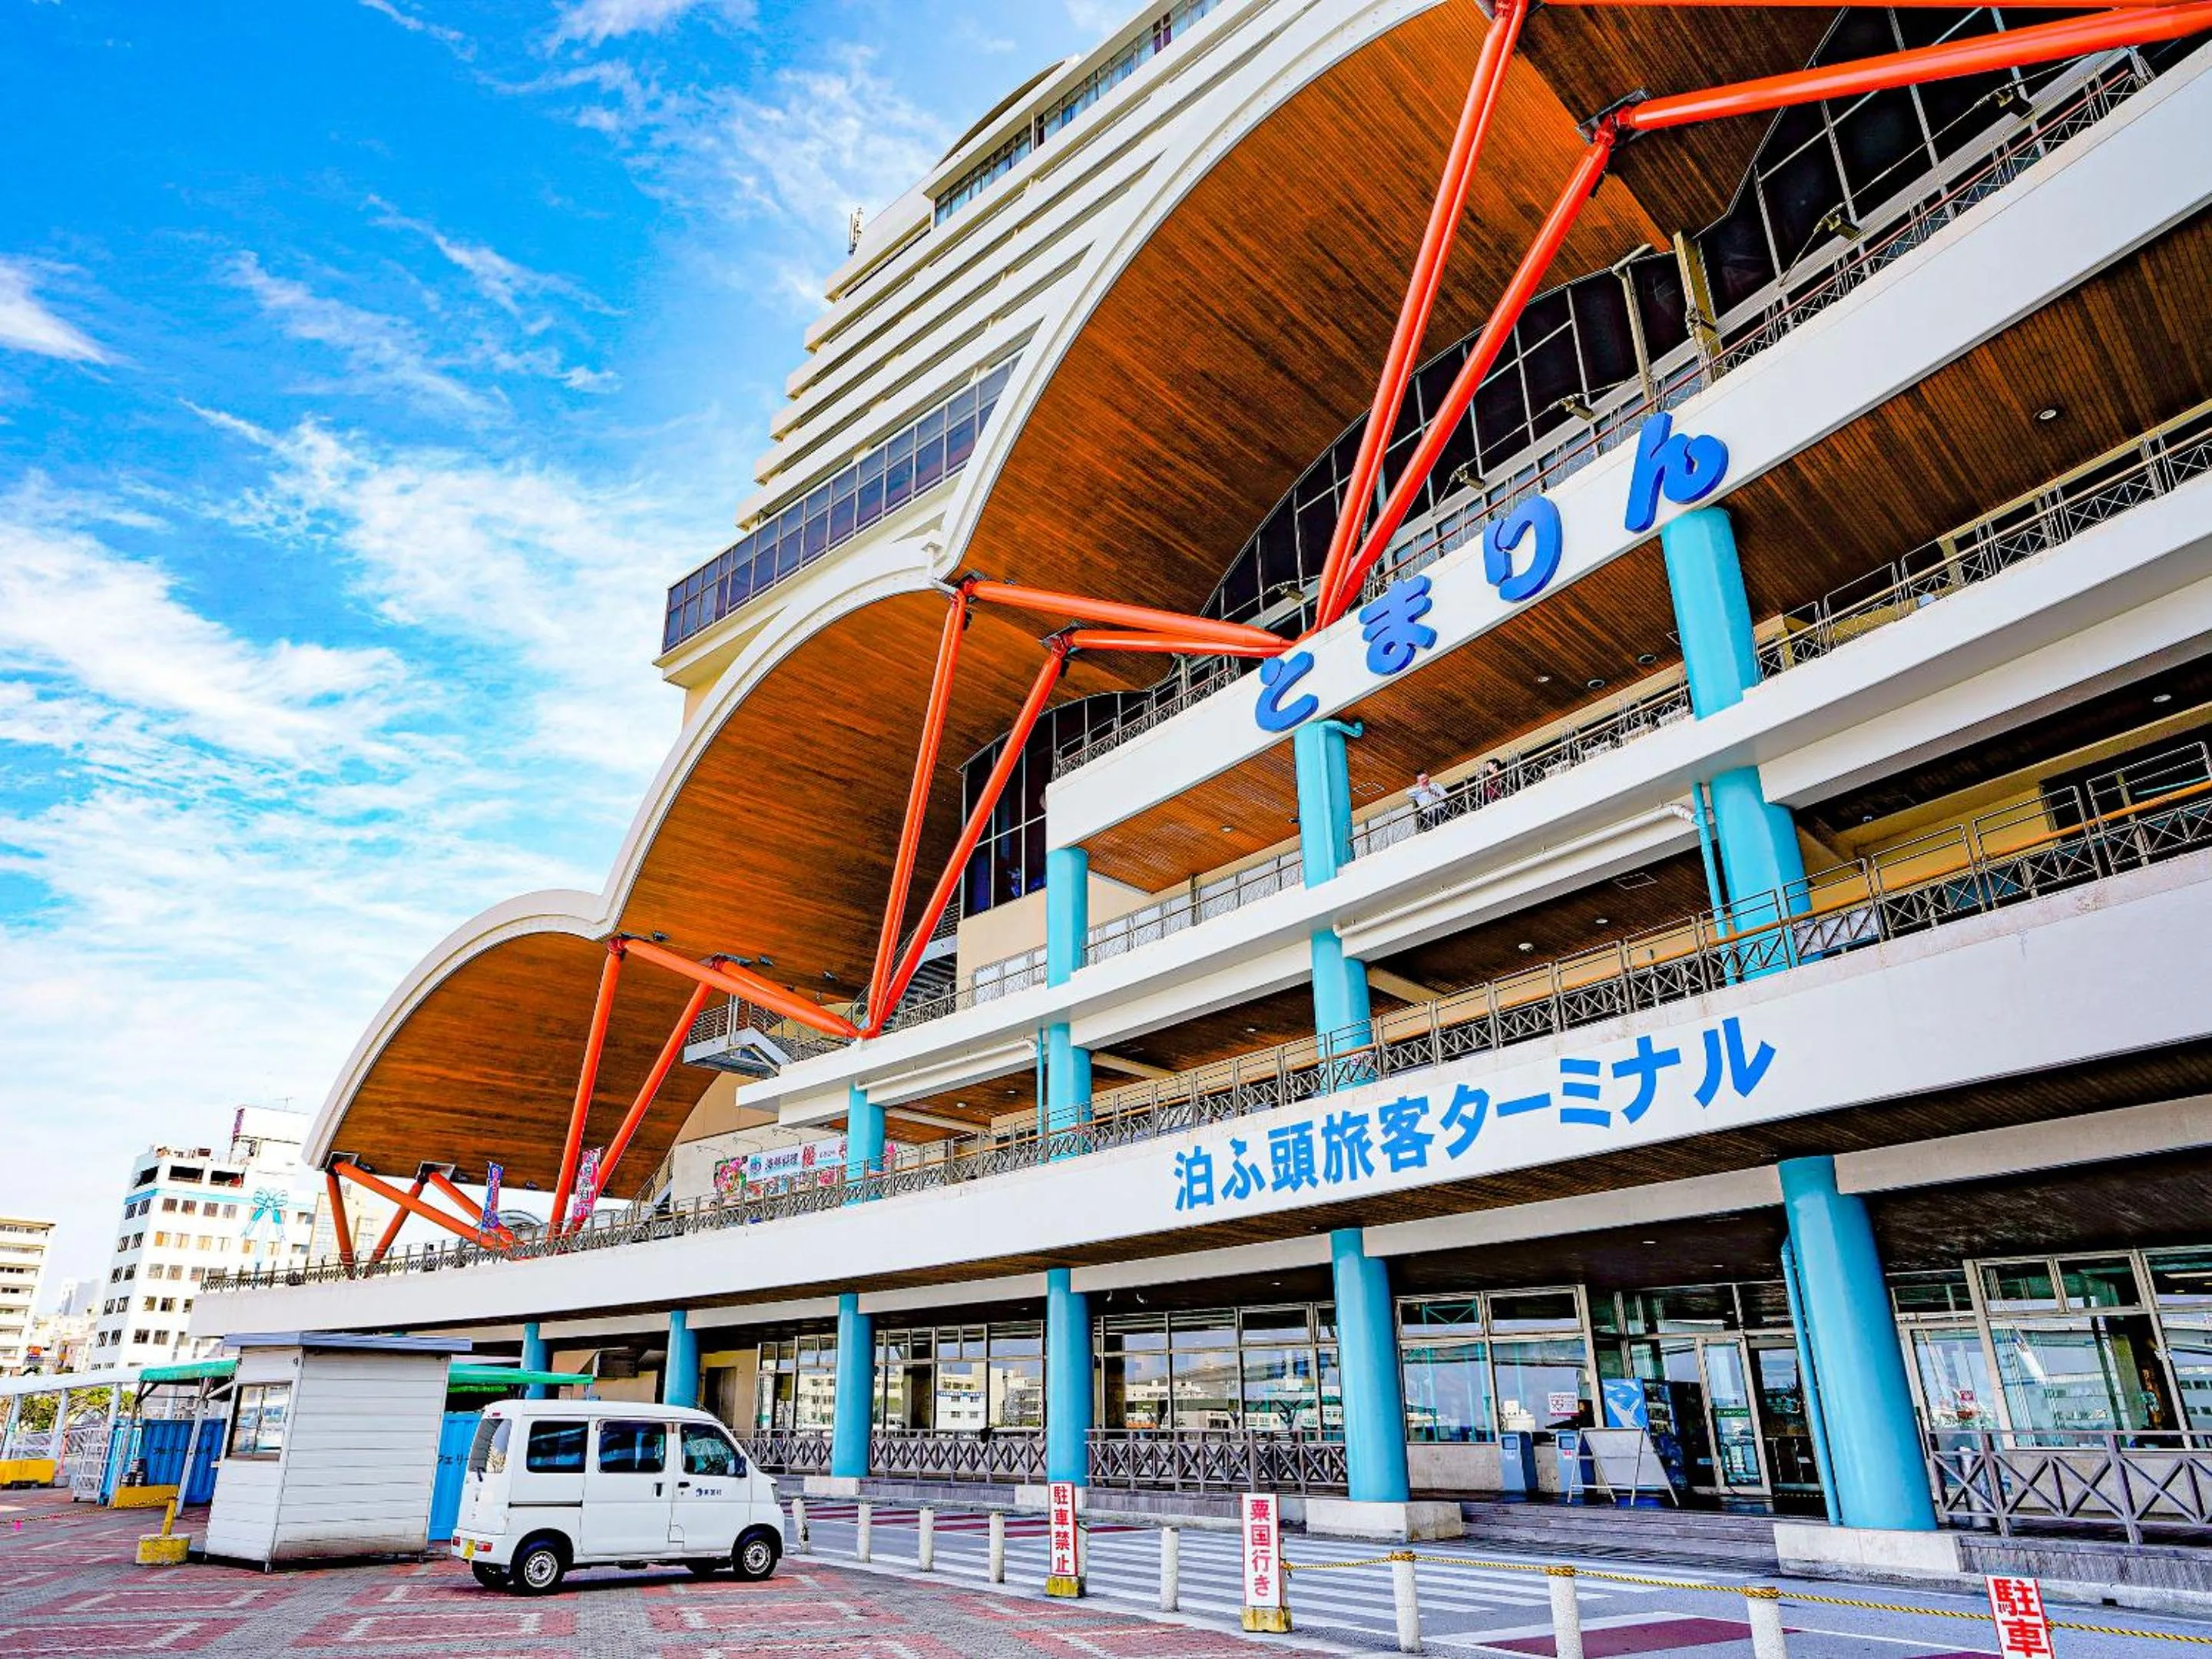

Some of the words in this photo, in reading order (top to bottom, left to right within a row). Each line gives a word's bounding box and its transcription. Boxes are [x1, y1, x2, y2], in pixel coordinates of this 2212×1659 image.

[1255, 412, 1728, 733] とまりん
[1174, 1016, 1777, 1212] 泊ふ頭旅客ターミナル
[1054, 1485, 1070, 1573] 駐車禁止
[1250, 1499, 1272, 1597] 粟国行き
[1993, 1579, 2048, 1657] 駐車
